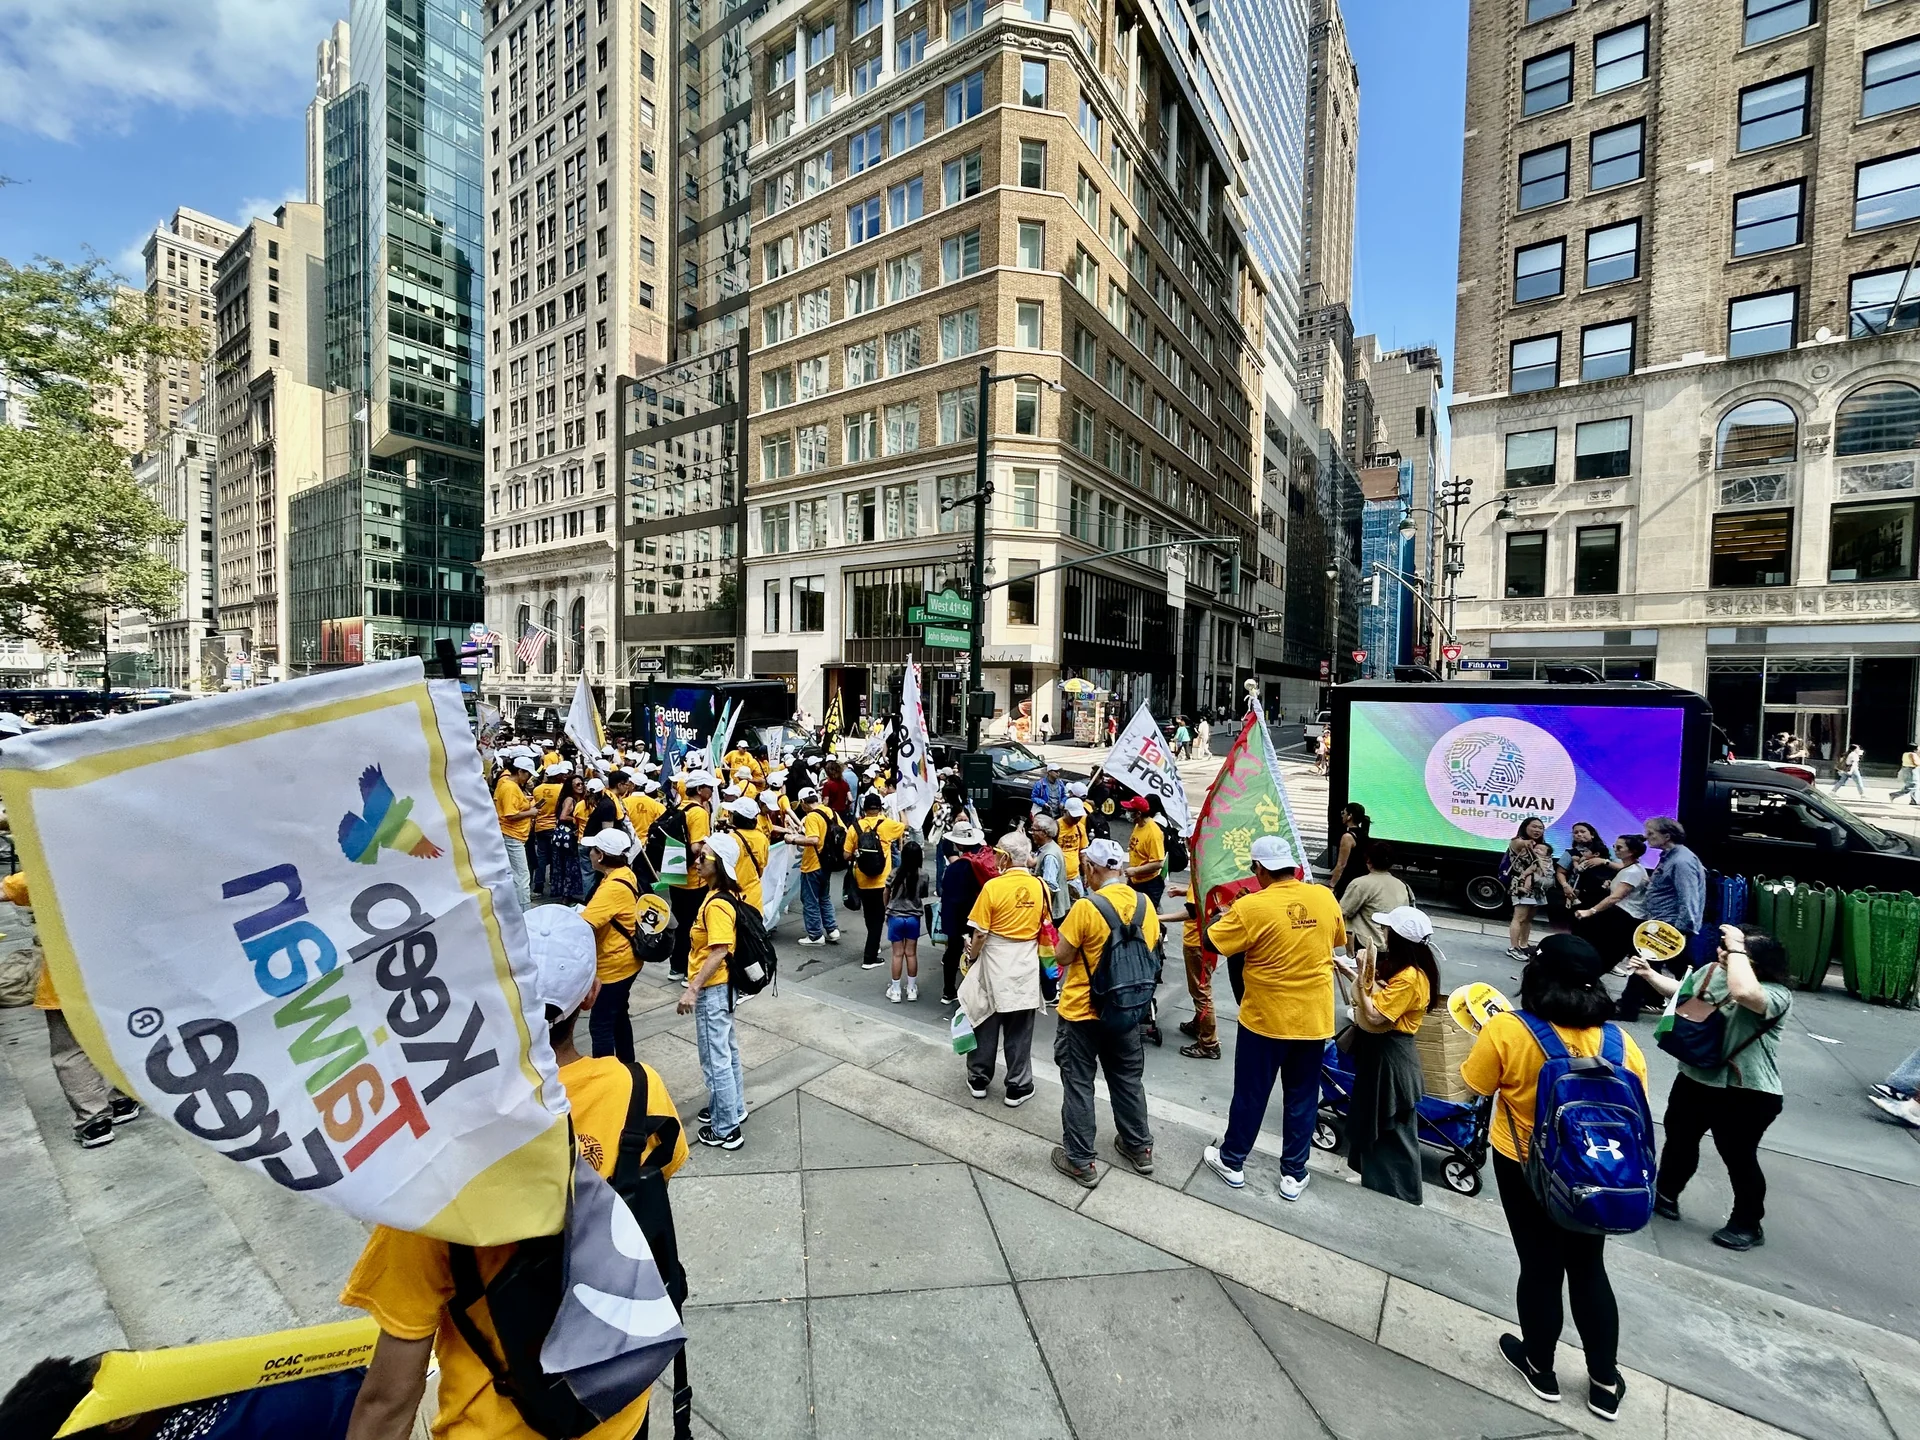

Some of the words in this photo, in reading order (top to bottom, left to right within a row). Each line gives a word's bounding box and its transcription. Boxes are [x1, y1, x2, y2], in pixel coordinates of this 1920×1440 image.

[930, 598, 948, 612] West
[962, 604, 969, 616] St
[928, 632, 940, 641] John
[940, 632, 959, 644] Bigelow
[658, 706, 690, 724] Better
[1127, 756, 1174, 798] Free
[1476, 792, 1555, 811] TAIWAN
[1451, 806, 1490, 818] Better
[264, 1353, 303, 1371] OCAC
[257, 1366, 304, 1384] TCCNA
